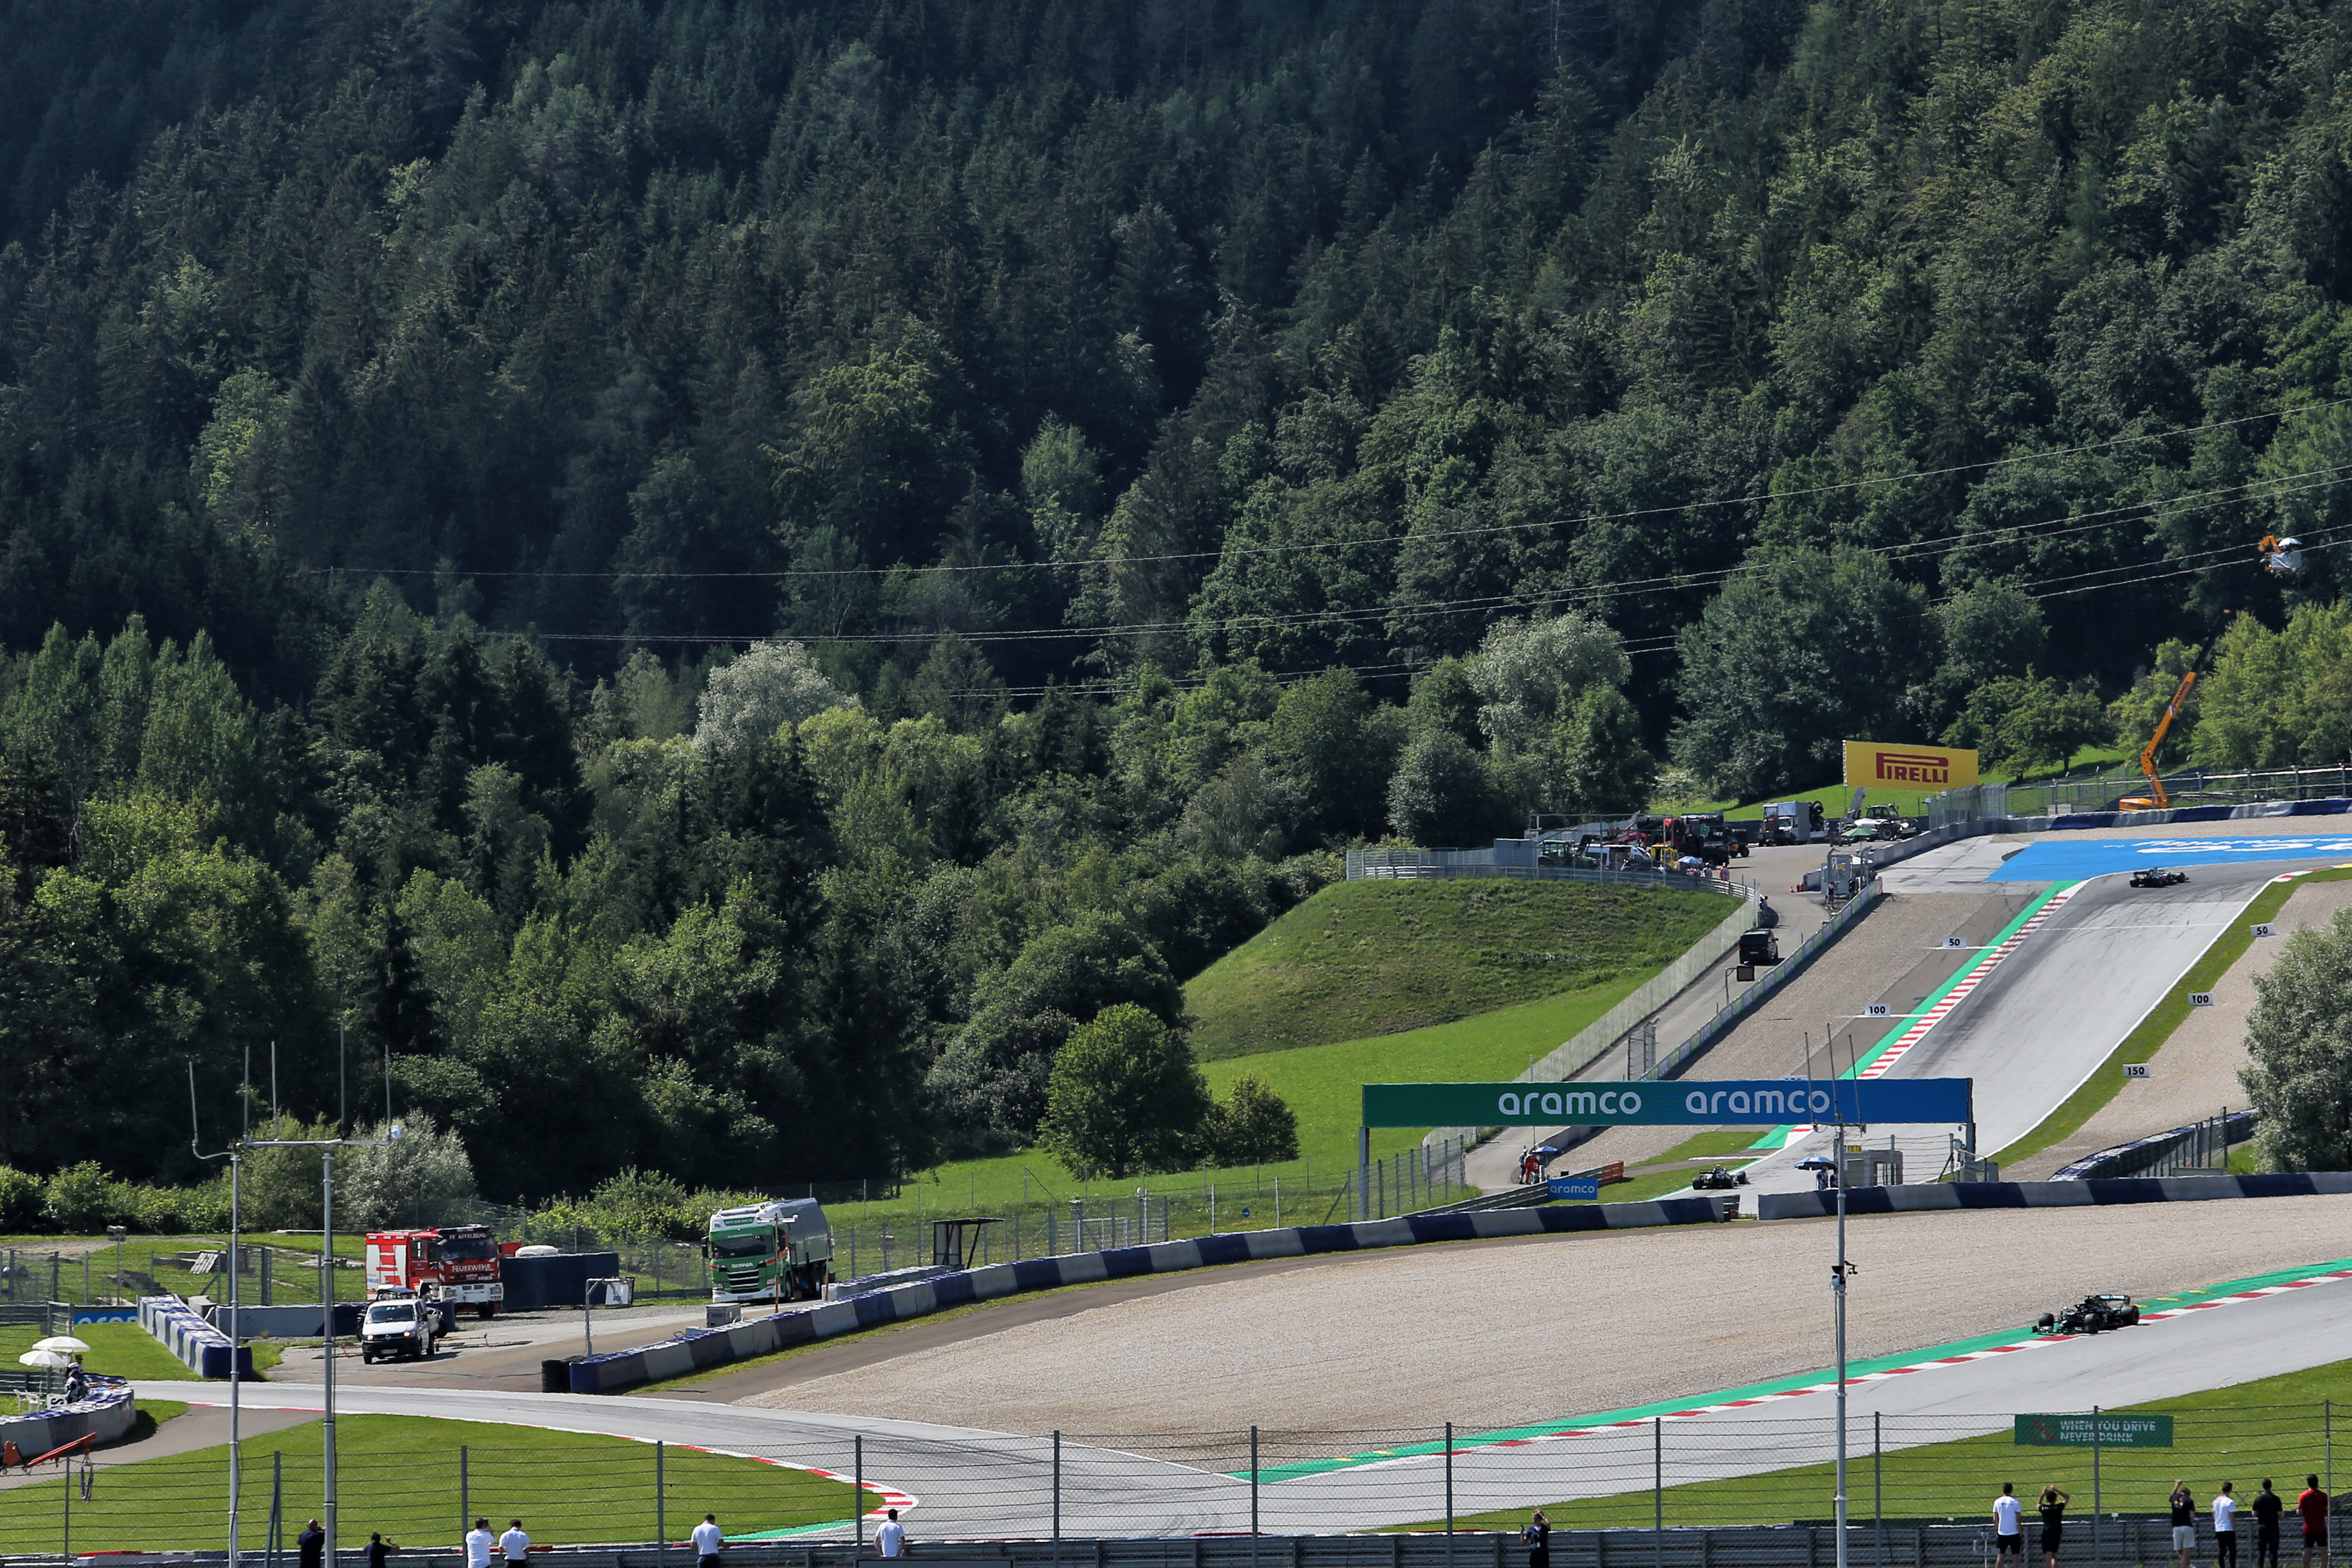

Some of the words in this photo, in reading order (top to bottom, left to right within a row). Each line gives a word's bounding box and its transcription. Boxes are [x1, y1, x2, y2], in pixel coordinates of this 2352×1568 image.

[1876, 752, 1948, 784] PIRELLI
[2257, 926, 2268, 935] 50
[2192, 995, 2209, 1004] 100
[1869, 1006, 1886, 1014] 100
[2127, 1067, 2145, 1075] 150
[1499, 1092, 1641, 1114] aramco
[1686, 1090, 1829, 1113] aramco
[1550, 1185, 1595, 1193] aramco
[2060, 1420, 2093, 1430] WHEN
[2098, 1421, 2120, 1431] YOU
[2123, 1421, 2156, 1431] DRIVE
[2060, 1432, 2095, 1441] NEVER
[2099, 1432, 2133, 1442] DRINK
